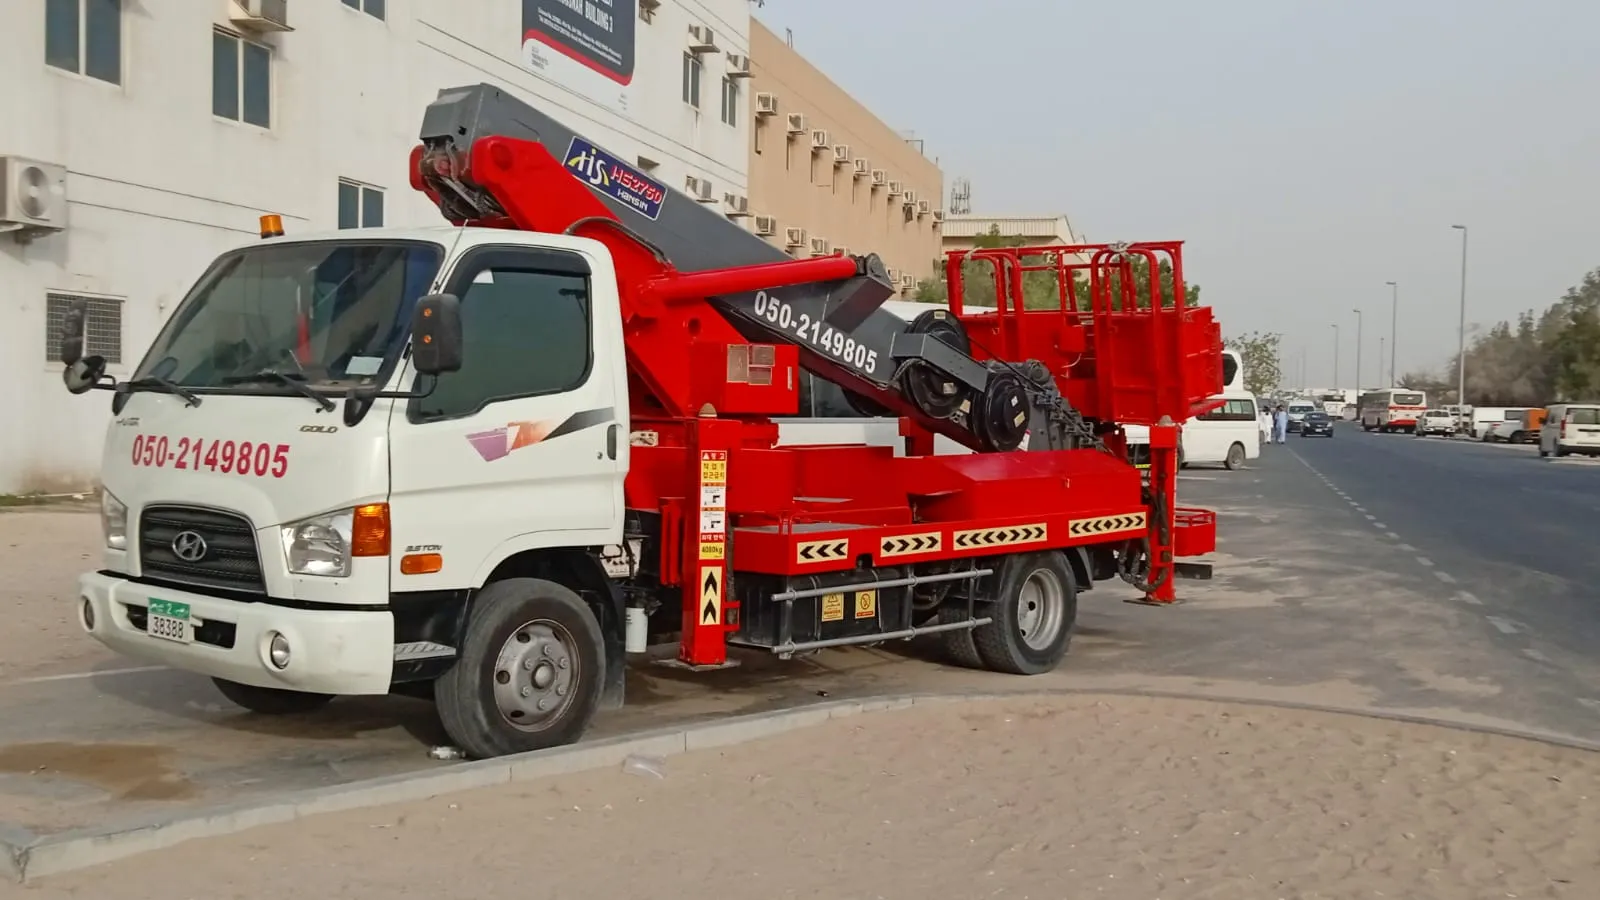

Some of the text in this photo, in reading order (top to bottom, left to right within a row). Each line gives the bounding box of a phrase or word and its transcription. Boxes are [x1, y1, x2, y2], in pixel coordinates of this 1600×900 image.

[610, 165, 663, 205] HS2750
[754, 290, 878, 374] 050-2149805
[300, 425, 338, 433] GOLD
[132, 434, 290, 478] 050-2149805
